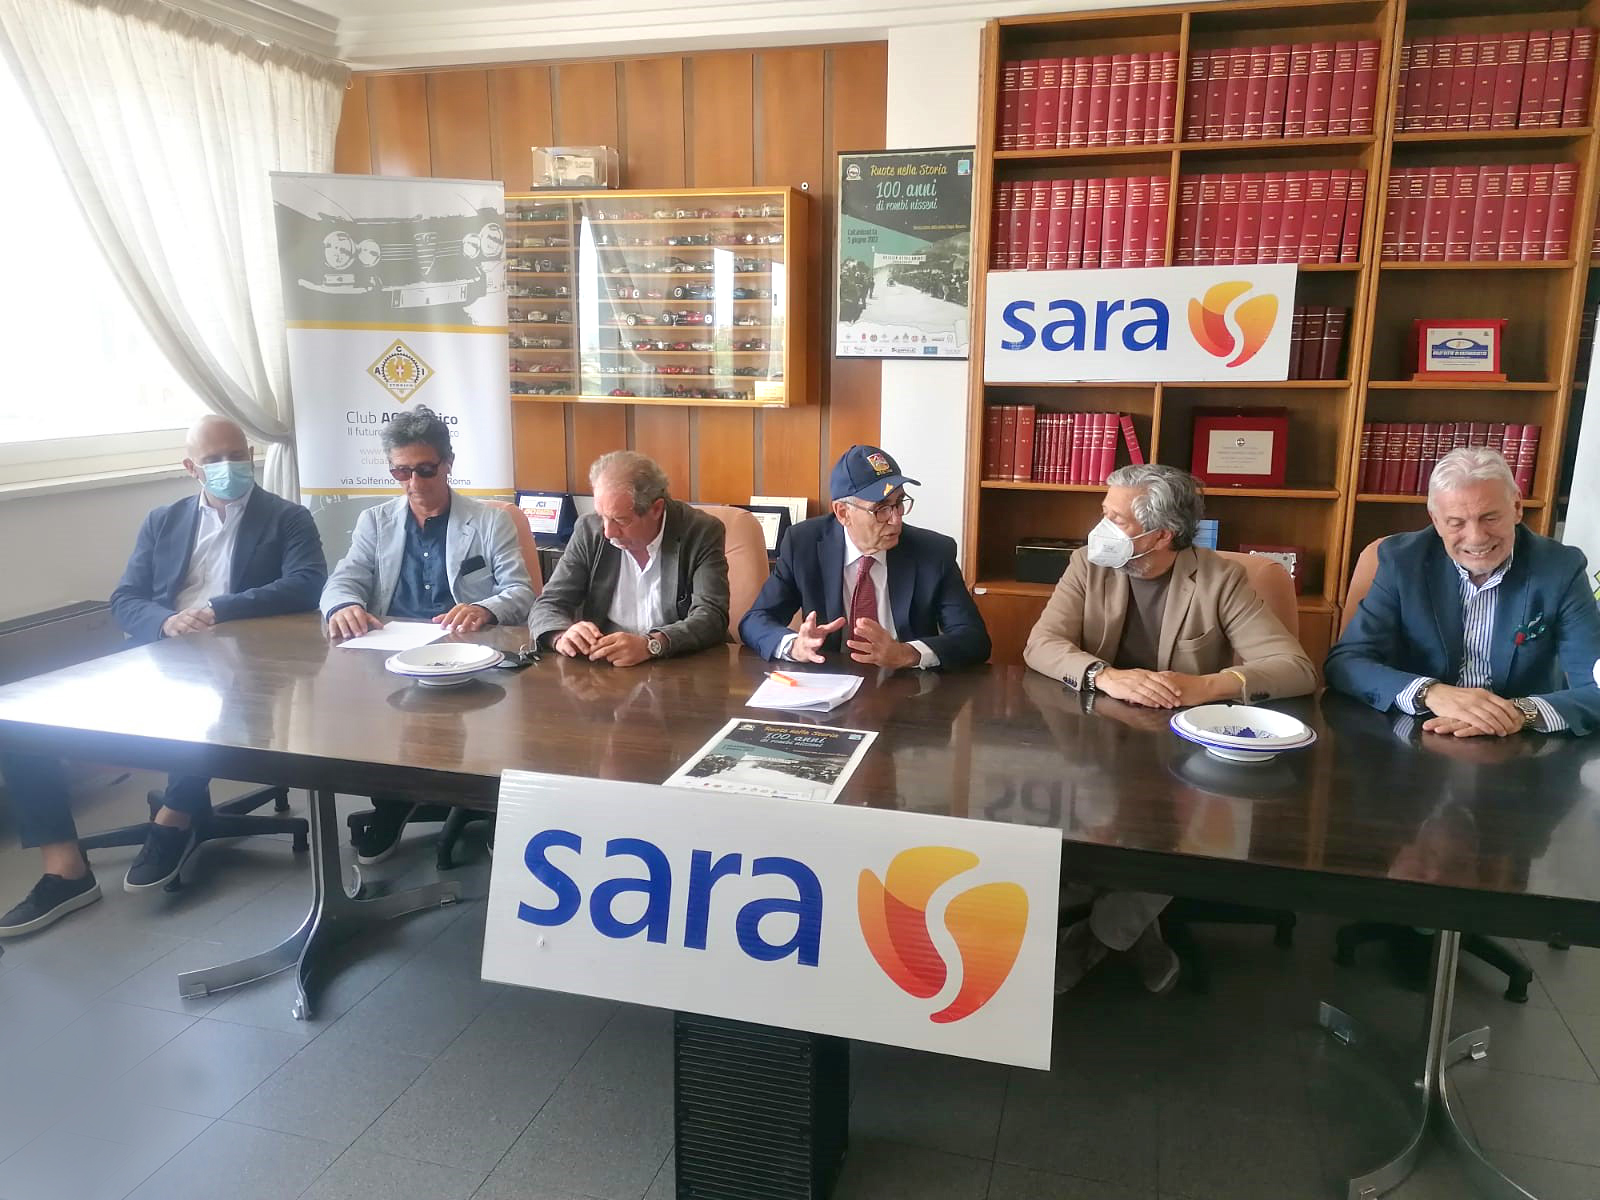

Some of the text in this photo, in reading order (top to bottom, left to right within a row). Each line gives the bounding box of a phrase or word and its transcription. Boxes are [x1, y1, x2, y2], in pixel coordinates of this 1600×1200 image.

[870, 163, 948, 176] Ruote nella Storia
[876, 178, 937, 199] 100 anni
[876, 198, 938, 211] di rombi nisseni
[1001, 298, 1170, 352] sara
[346, 411, 377, 424] Club
[340, 476, 354, 485] via
[356, 475, 396, 485] Solferino
[447, 477, 472, 486] Roma
[794, 736, 827, 744] anni
[517, 829, 824, 968] sara
